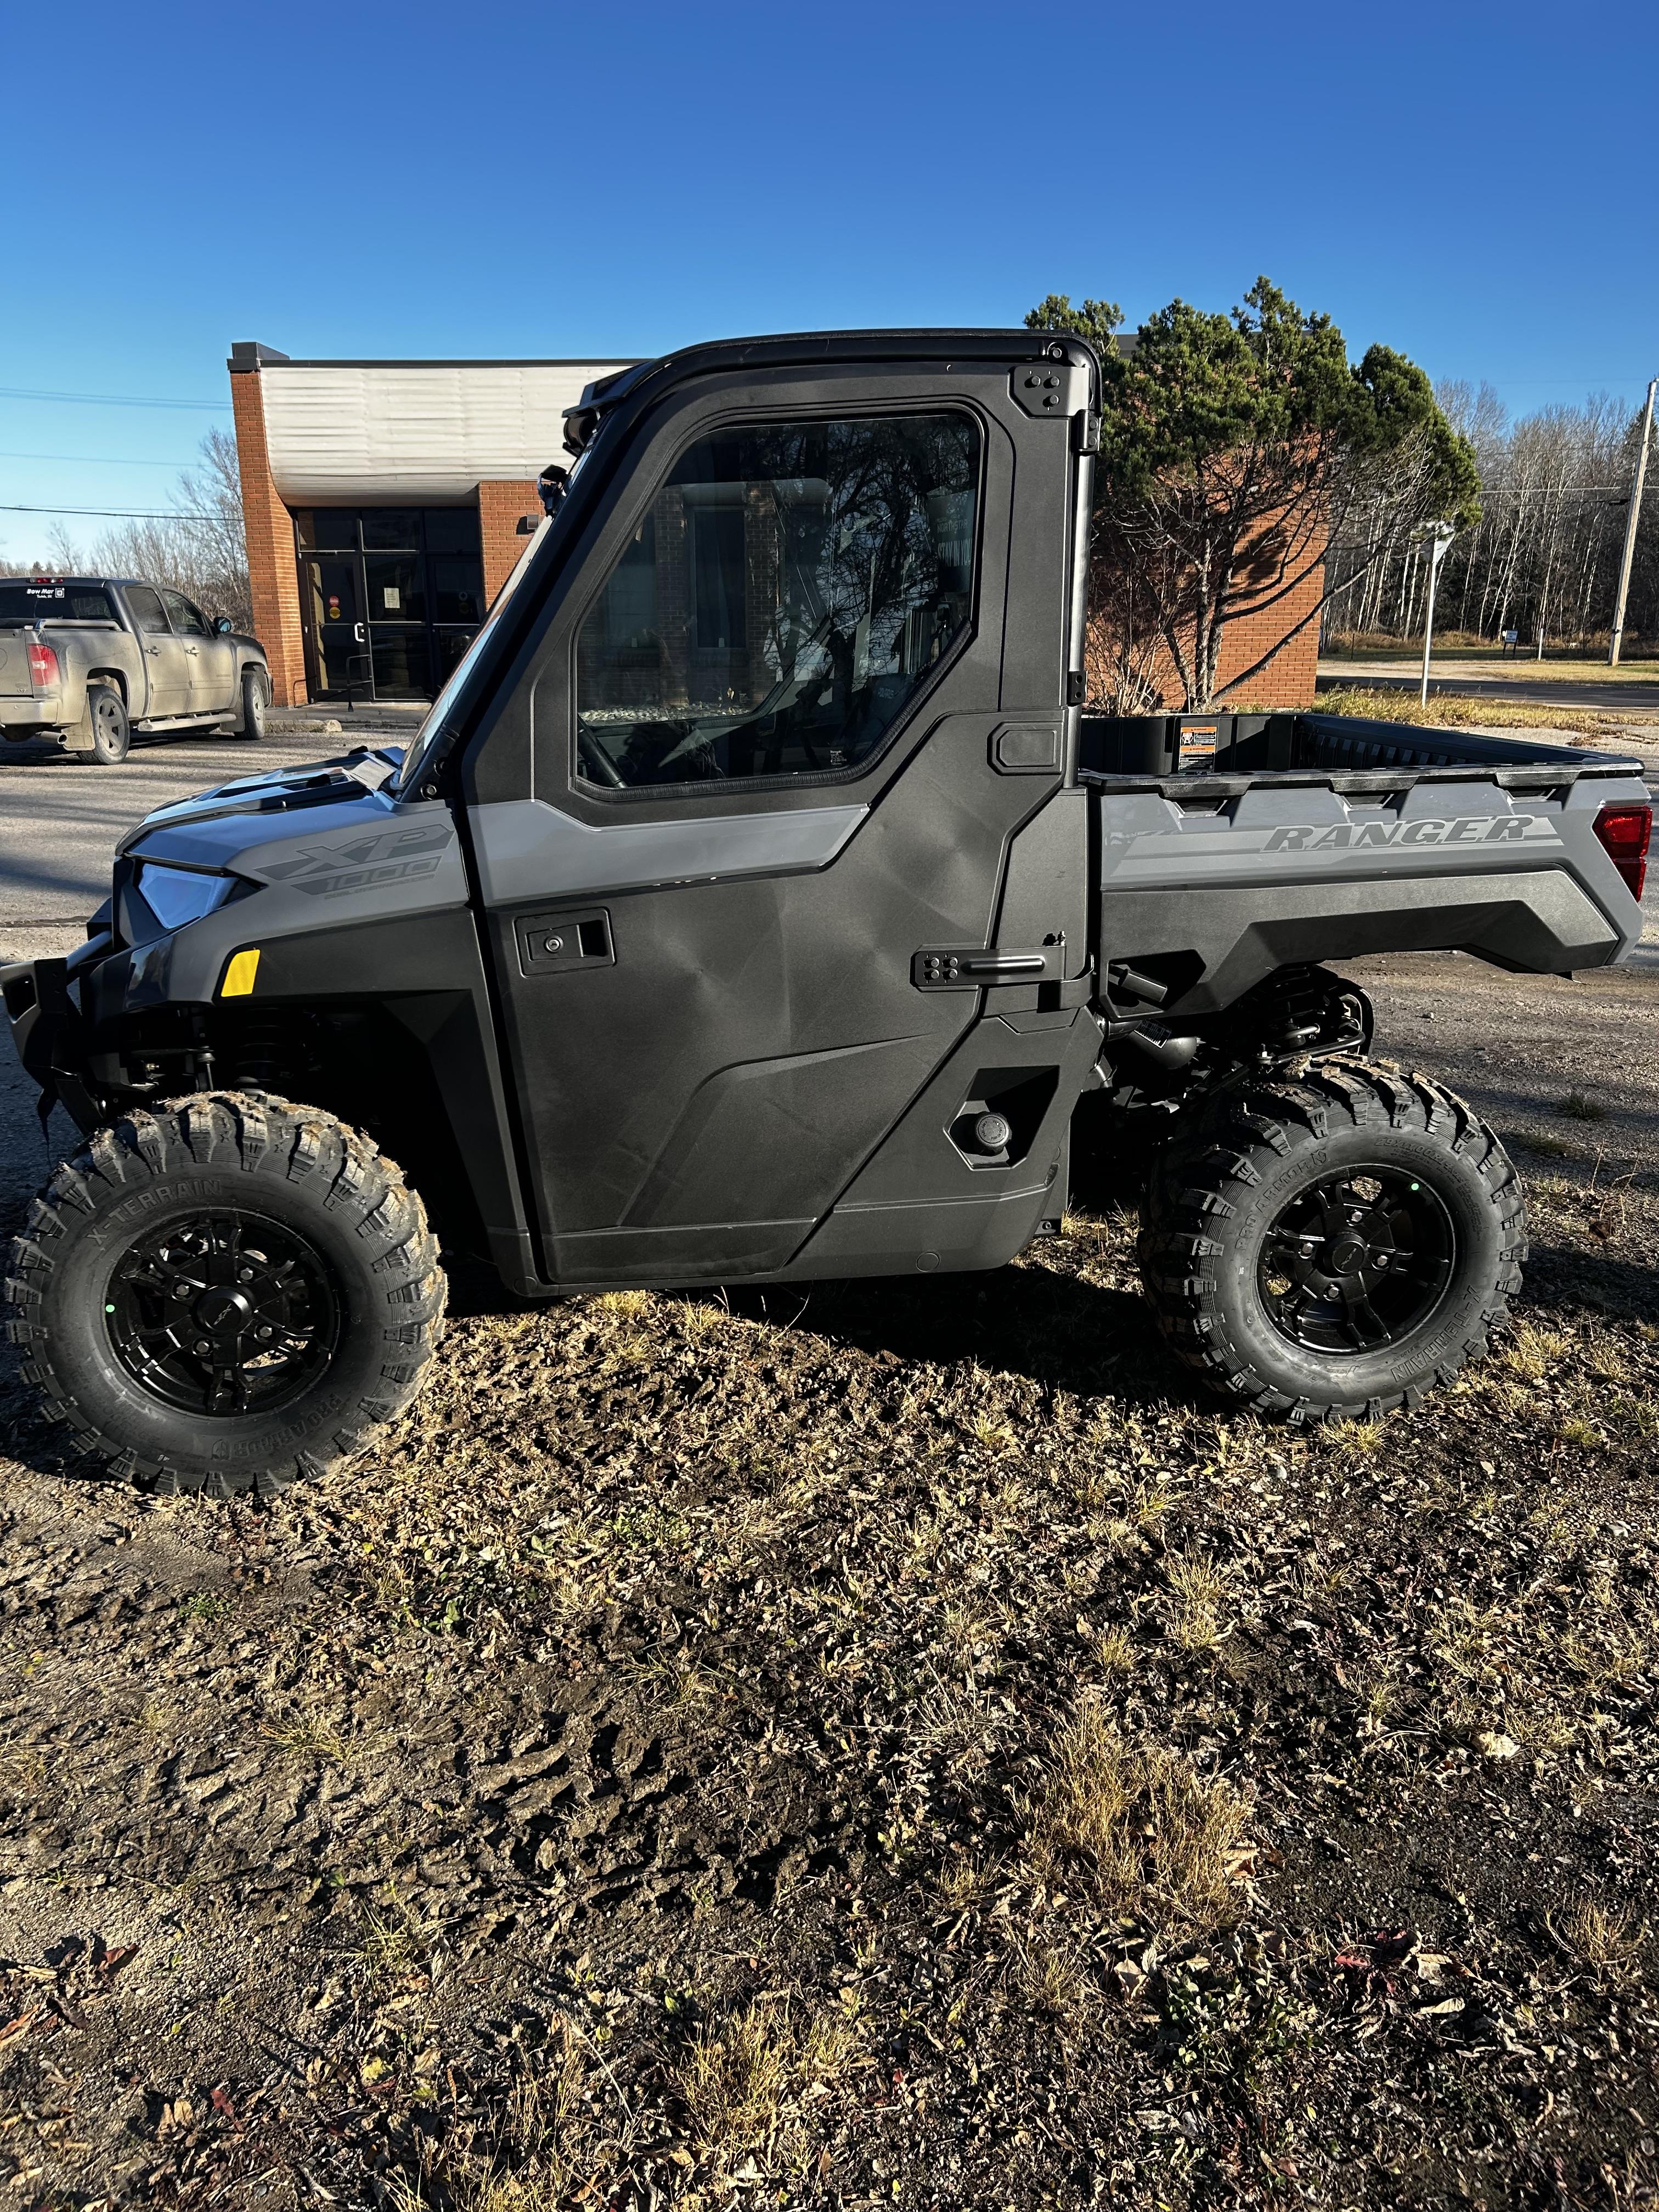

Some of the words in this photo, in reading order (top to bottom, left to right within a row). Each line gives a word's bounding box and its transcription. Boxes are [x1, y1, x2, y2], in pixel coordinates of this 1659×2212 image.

[937, 519, 968, 533] NORTHSTAR
[269, 823, 456, 881] XP
[1260, 815, 1534, 853] RANGER
[325, 857, 440, 891] 1000
[87, 1180, 222, 1246] X-TERRAIN
[1235, 1214, 1256, 1250] PRO
[1255, 1159, 1312, 1214] ARMOR
[1390, 1285, 1481, 1383] X-TERRAIN
